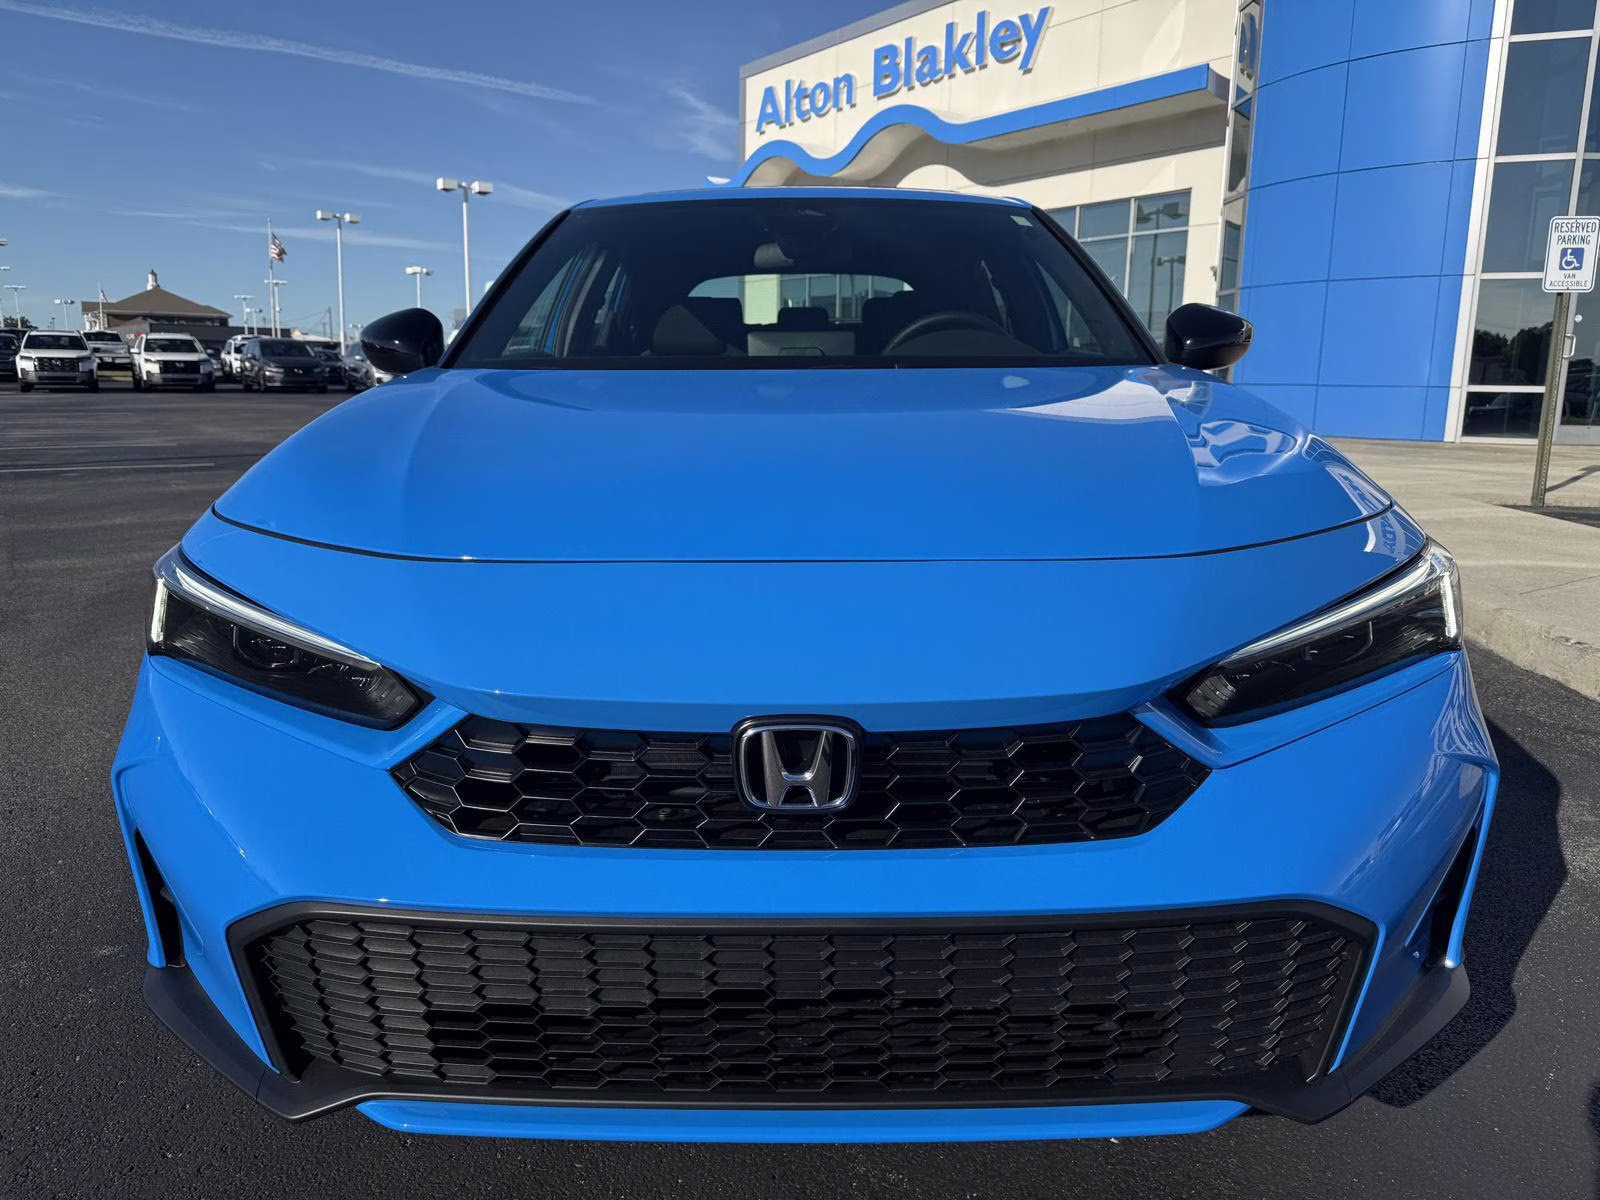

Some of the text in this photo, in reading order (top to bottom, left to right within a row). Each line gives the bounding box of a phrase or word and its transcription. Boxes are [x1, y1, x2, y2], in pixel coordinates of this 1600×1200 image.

[756, 6, 1053, 134] Alton Blakley
[1554, 221, 1597, 233] RESERVED
[1557, 234, 1591, 245] PARKING
